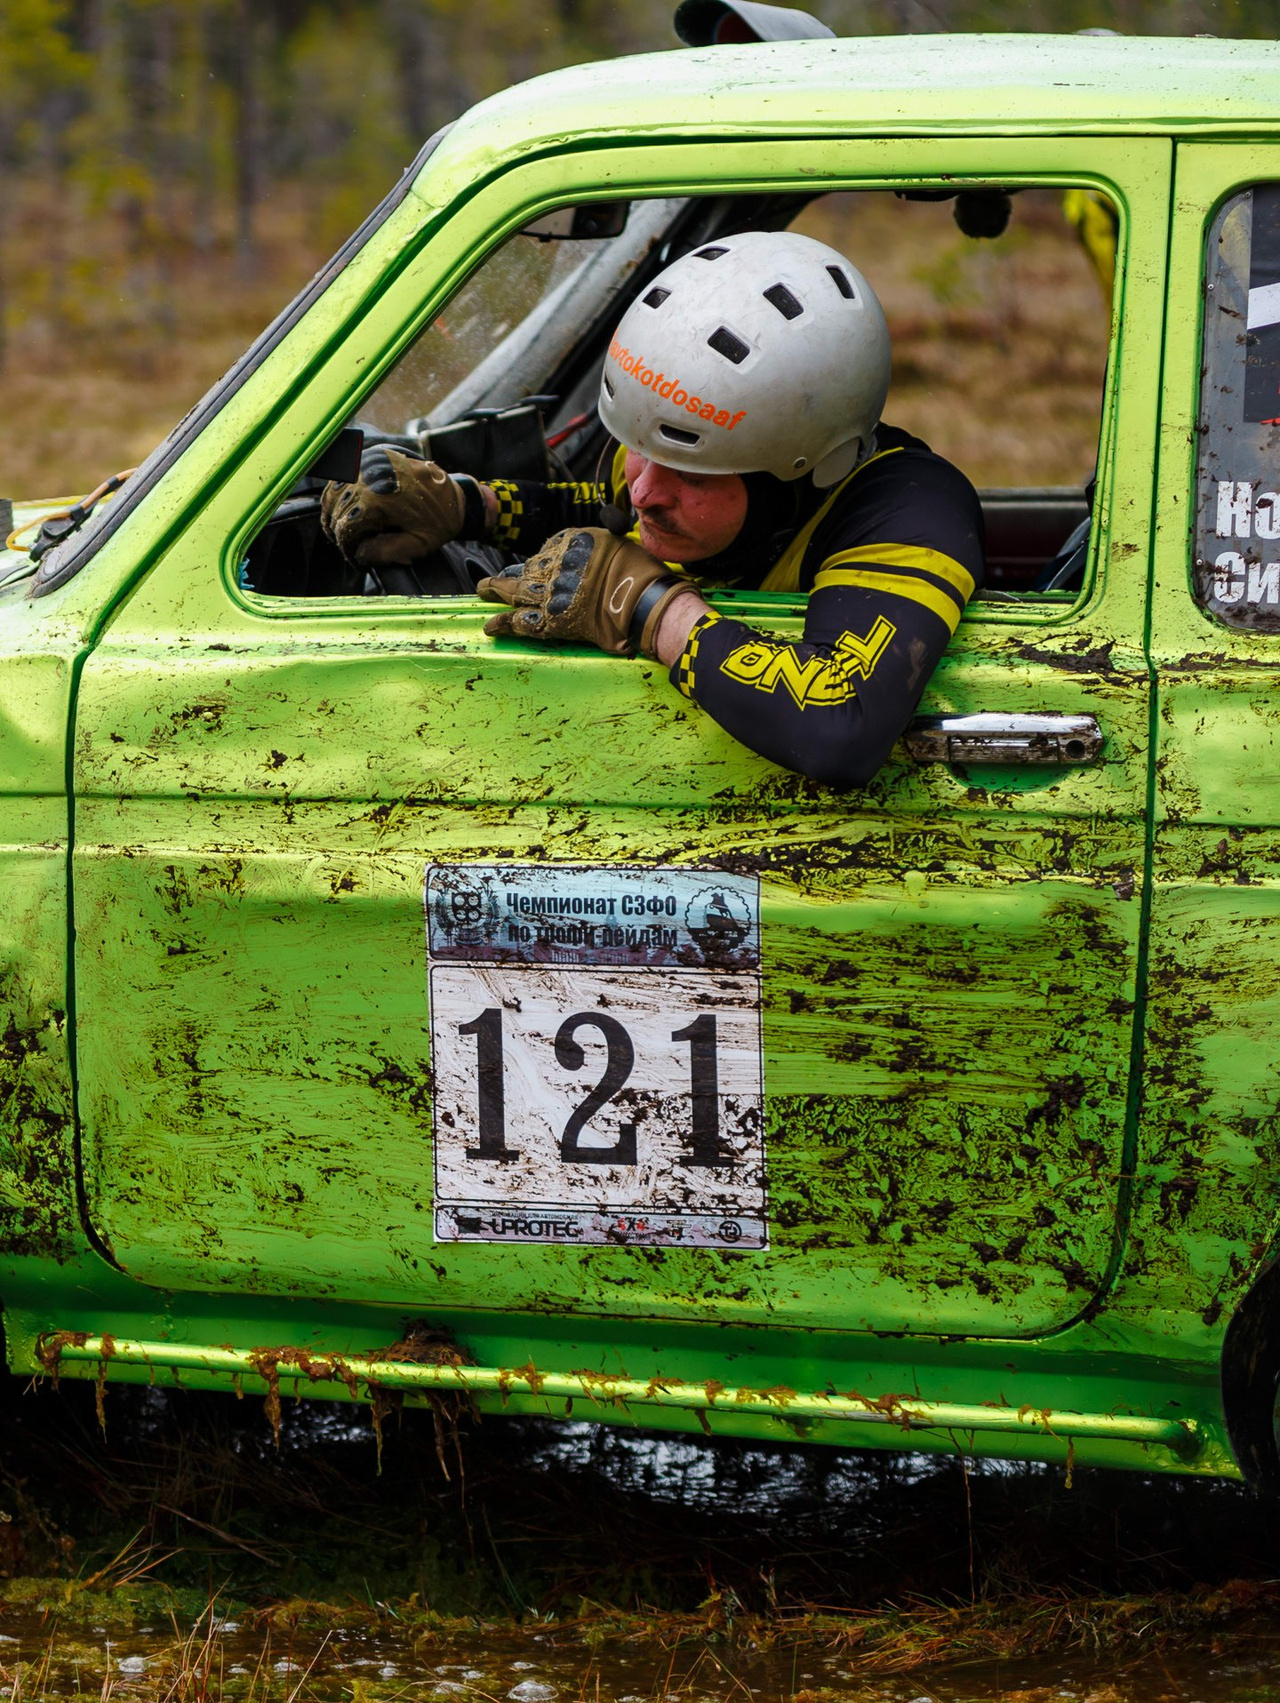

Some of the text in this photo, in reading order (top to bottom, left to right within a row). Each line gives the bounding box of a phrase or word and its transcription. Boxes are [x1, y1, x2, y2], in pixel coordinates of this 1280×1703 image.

[506, 892, 677, 917] Чемпионат СЗФО
[508, 925, 531, 943] по
[458, 1008, 738, 1167] 121
